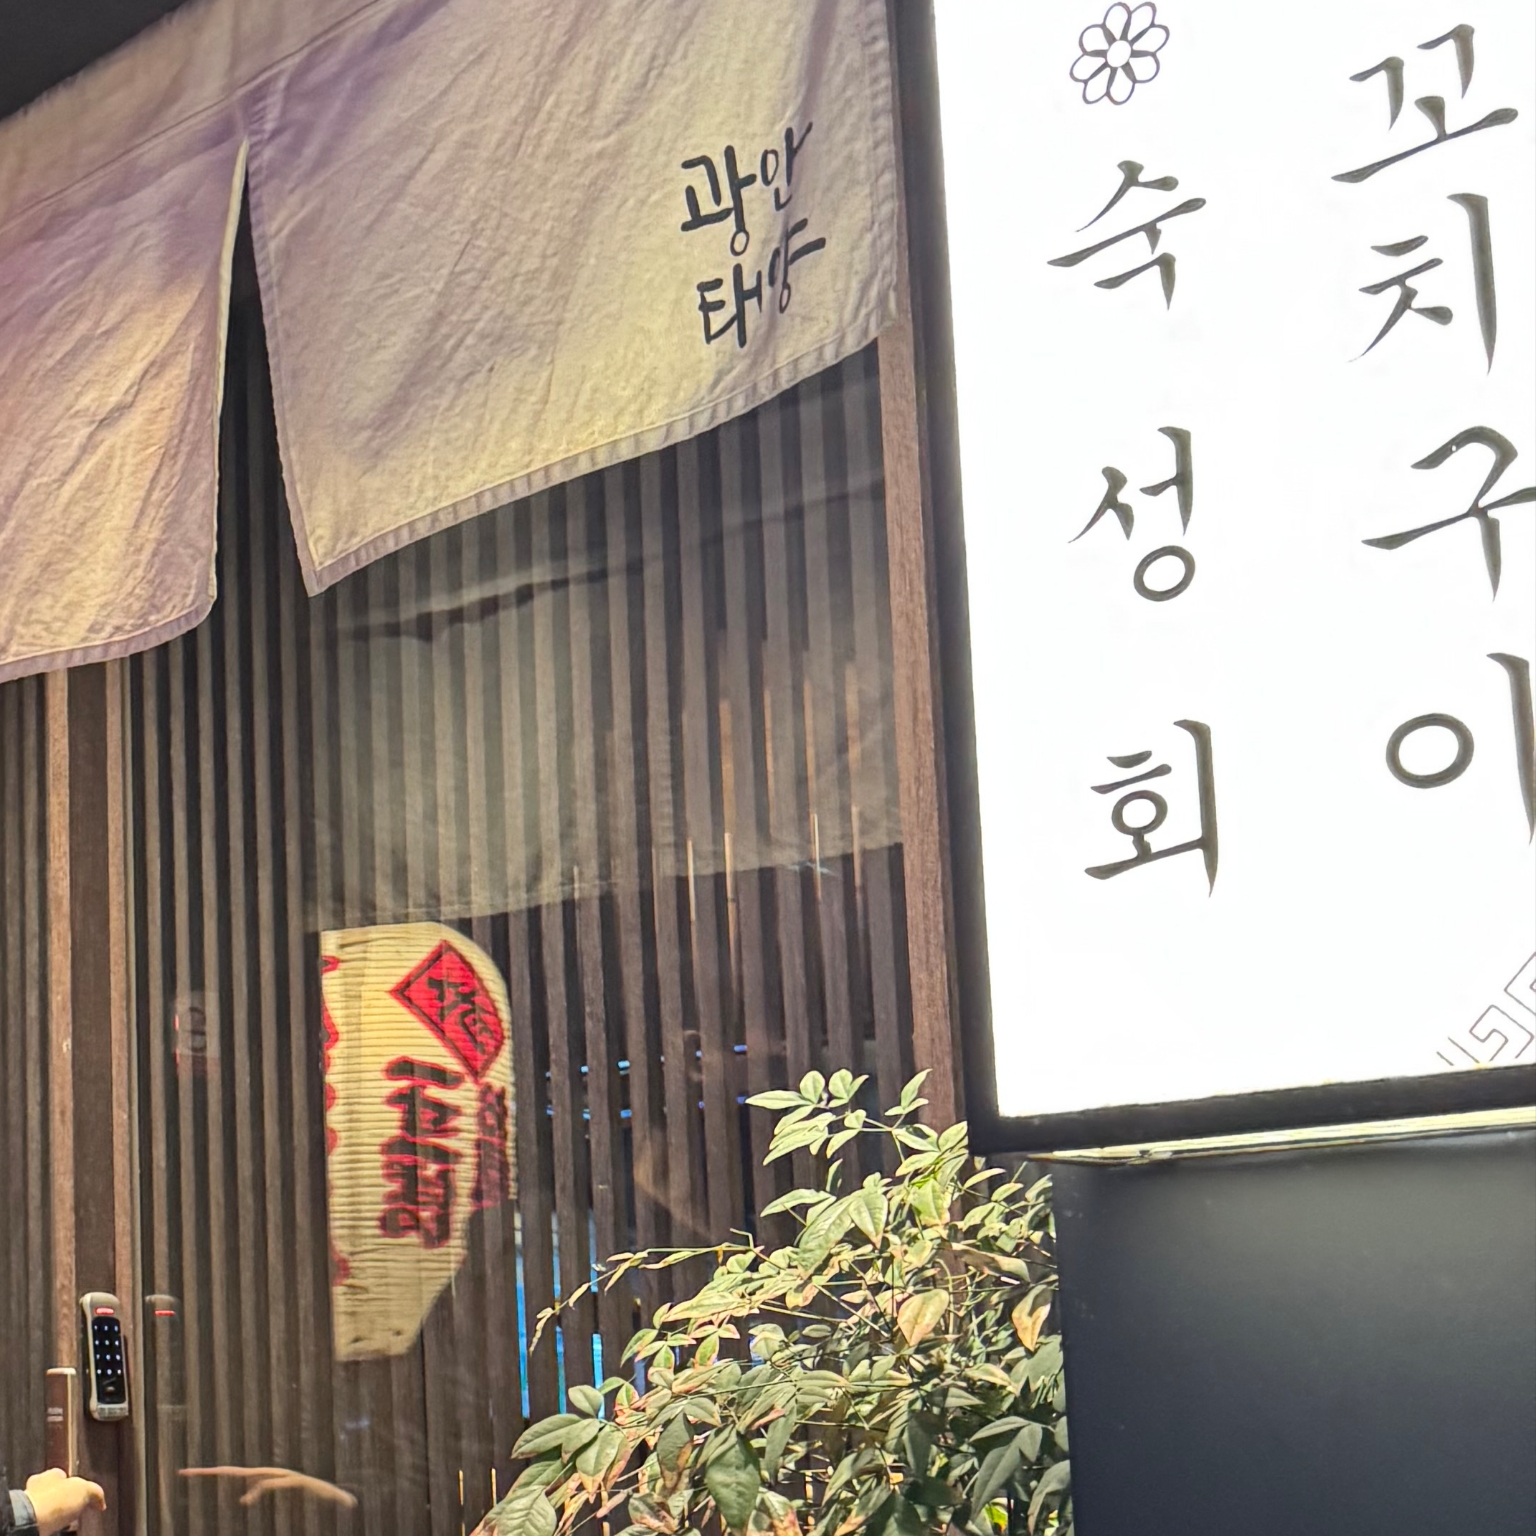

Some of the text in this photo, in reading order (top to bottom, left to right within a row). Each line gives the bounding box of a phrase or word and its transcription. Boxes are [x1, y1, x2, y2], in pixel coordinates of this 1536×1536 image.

[680, 121, 814, 257] 광안
[696, 217, 827, 349] 태양
[1047, 159, 1220, 898] 숙성회
[1330, 23, 1536, 846] 꼬치구이
